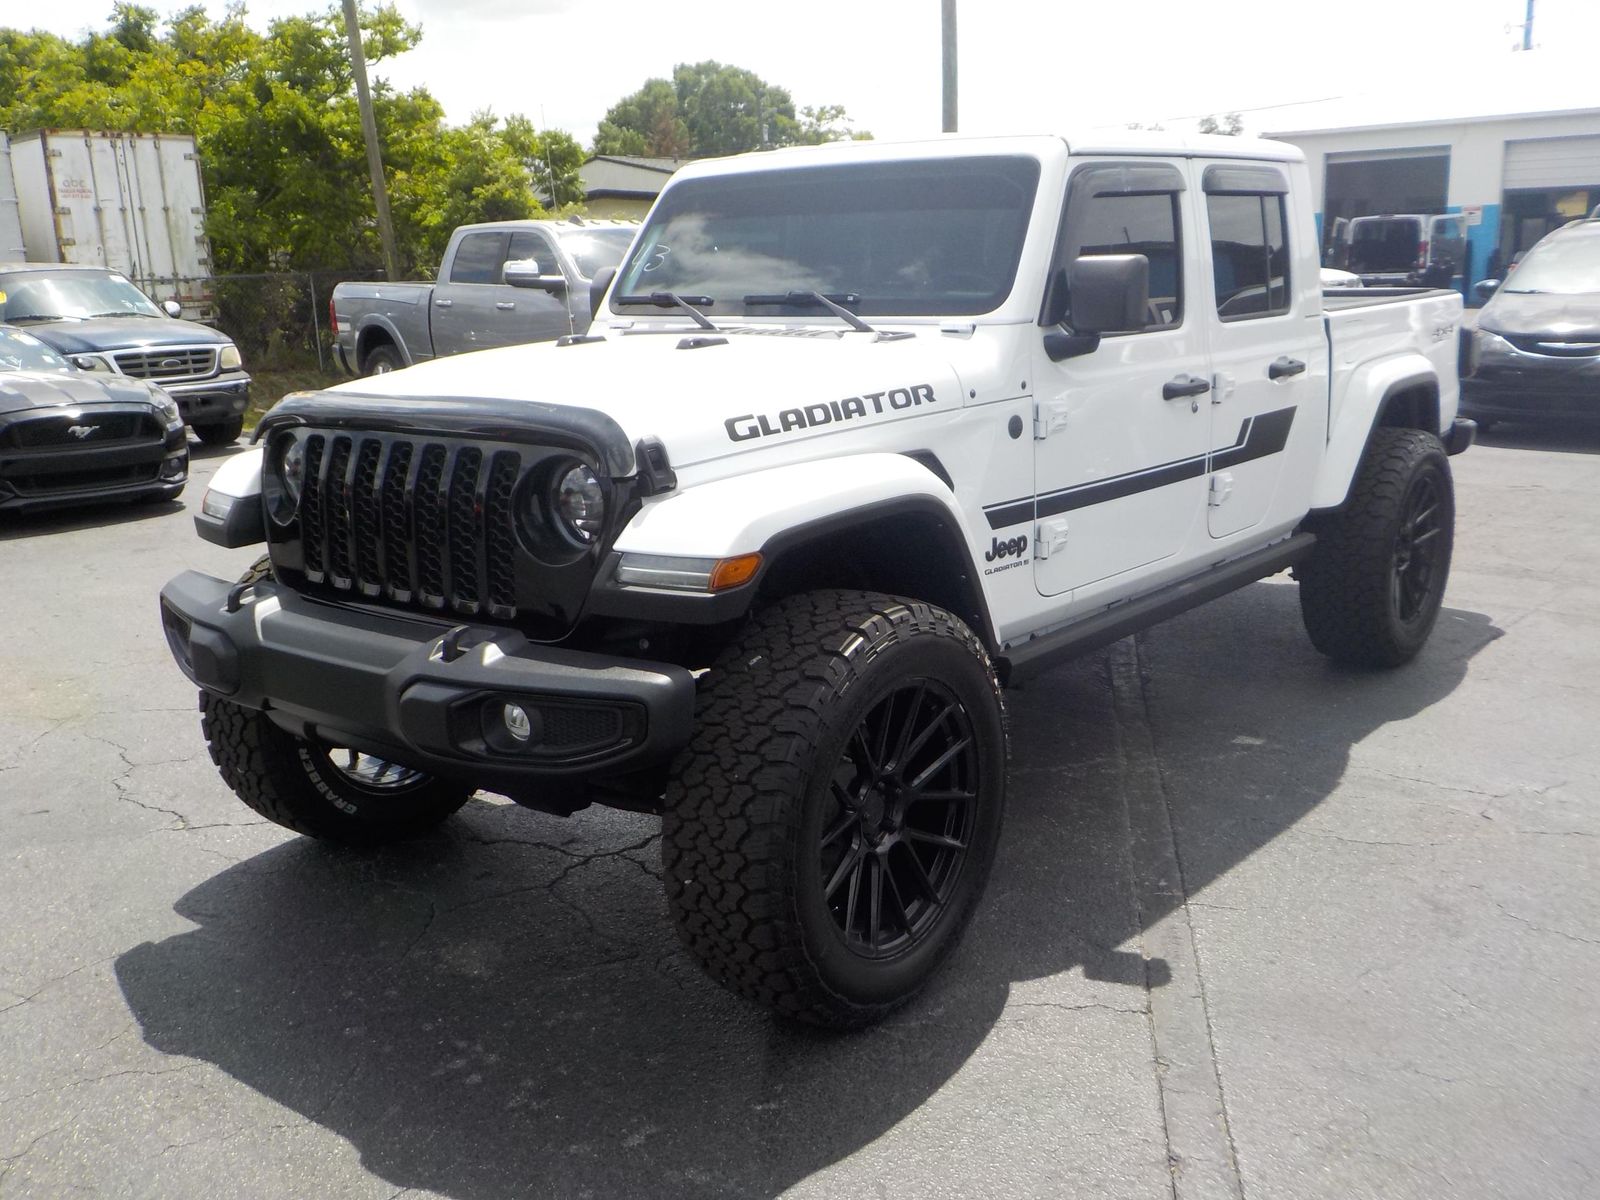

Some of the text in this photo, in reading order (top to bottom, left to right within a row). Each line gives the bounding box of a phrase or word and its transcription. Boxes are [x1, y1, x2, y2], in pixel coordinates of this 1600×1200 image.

[723, 383, 936, 443] GLADIATOR
[984, 561, 1023, 576] GLADIATOR
[985, 534, 1028, 562] Jeep
[297, 747, 358, 814] GRABBER
